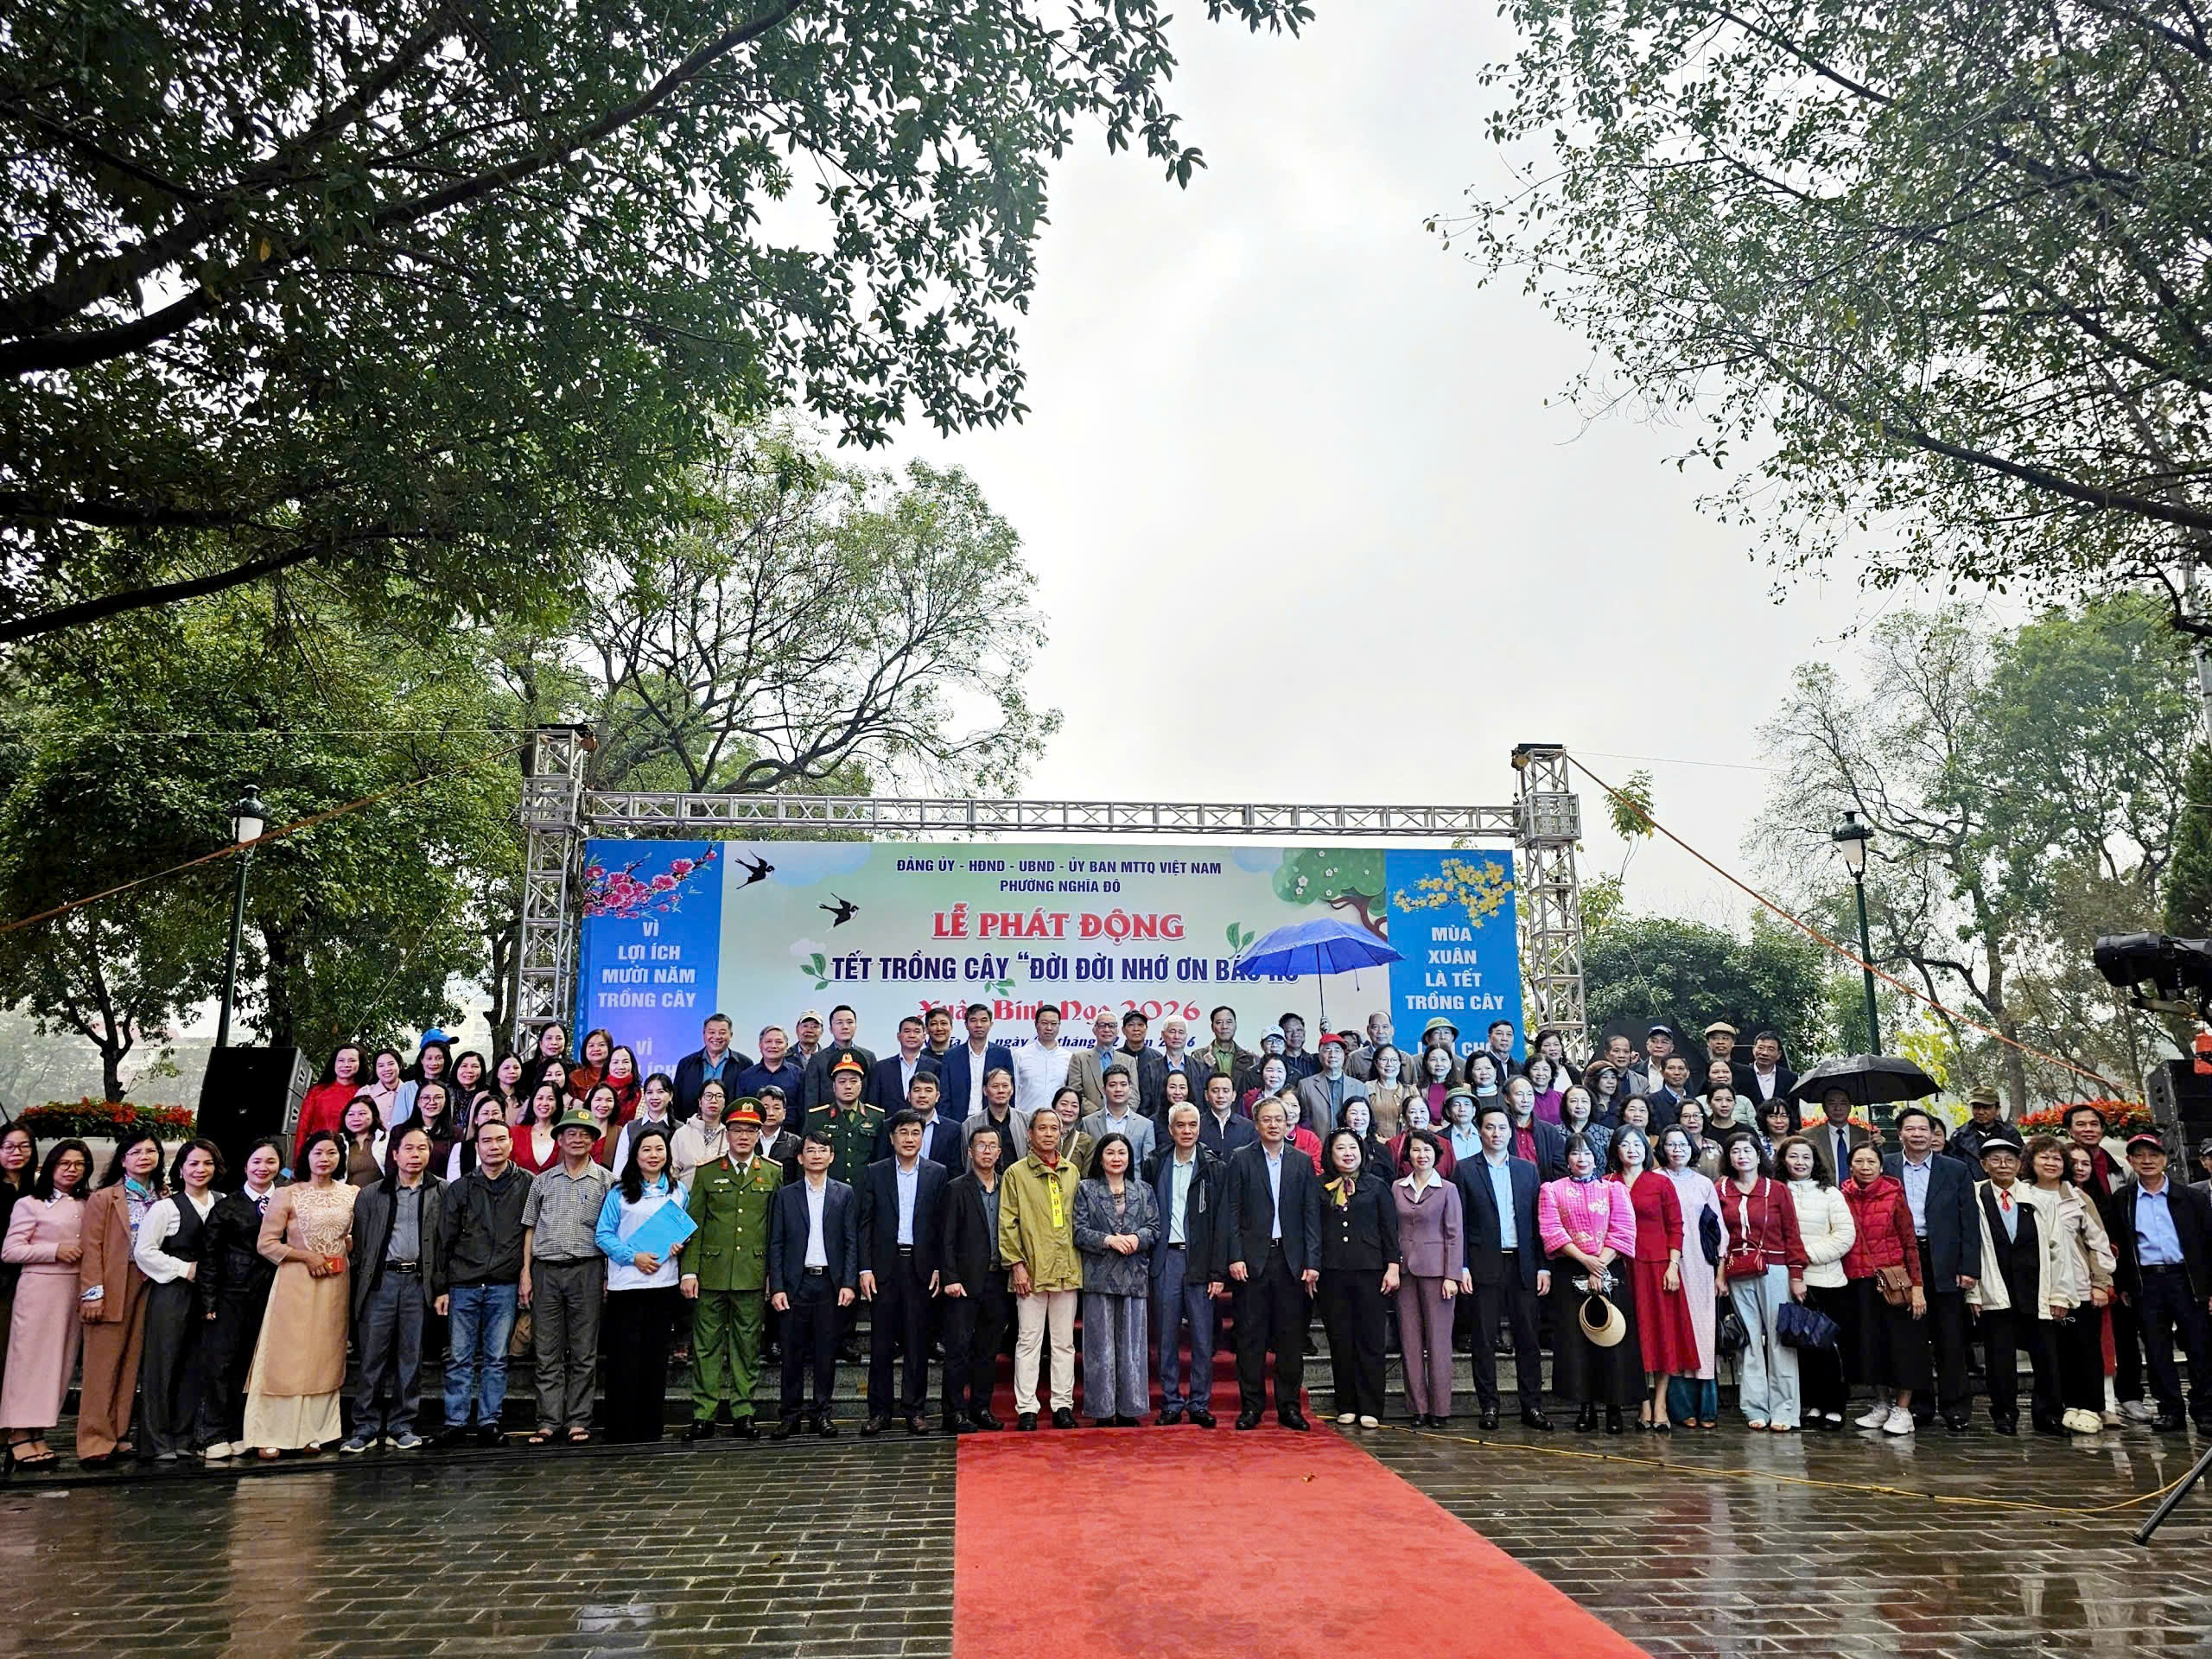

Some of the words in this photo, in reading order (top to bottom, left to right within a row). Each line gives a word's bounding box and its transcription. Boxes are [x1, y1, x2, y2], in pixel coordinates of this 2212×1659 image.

[897, 856, 934, 872] ĐẢNG
[938, 856, 955, 872] ỦY
[969, 860, 1006, 872] HĐND
[1019, 861, 1055, 872] UBND
[1068, 856, 1085, 873] ỦY
[1090, 861, 1116, 873] BAN
[1121, 861, 1156, 874] MTTQ
[1160, 860, 1187, 876] VIỆT
[1191, 862, 1222, 874] NAM
[1000, 877, 1054, 893] PHƯỜNG
[1058, 878, 1099, 893] NGHĨA
[1103, 879, 1121, 893] ĐÔ
[642, 918, 659, 937] VÌ
[933, 902, 969, 938] LỄ
[978, 907, 1071, 938] PHÁT
[1079, 908, 1185, 943] ĐỘNG
[1431, 925, 1472, 942] MÙA
[618, 943, 645, 963] LỢI
[651, 943, 681, 960] ÍCH
[1428, 947, 1477, 964] XUÂN
[602, 965, 649, 983] MƯỜI
[654, 965, 696, 983] NĂM
[832, 950, 873, 980] TẾT
[880, 950, 957, 980] TRỒNG
[964, 952, 1009, 980] CÂY
[1075, 952, 1113, 980] ĐỜI
[1122, 954, 1169, 981] NHỚ
[1176, 956, 1207, 981] ƠN
[1216, 954, 1261, 982] BÁ
[1425, 969, 1447, 987] LÀ
[1452, 967, 1483, 987] TẾT
[597, 988, 657, 1008] TRỒNG
[661, 989, 697, 1008] CÂY
[1405, 991, 1465, 1010] TRỒNG
[1470, 993, 1504, 1010] CÂY
[917, 999, 968, 1020] Xuâ
